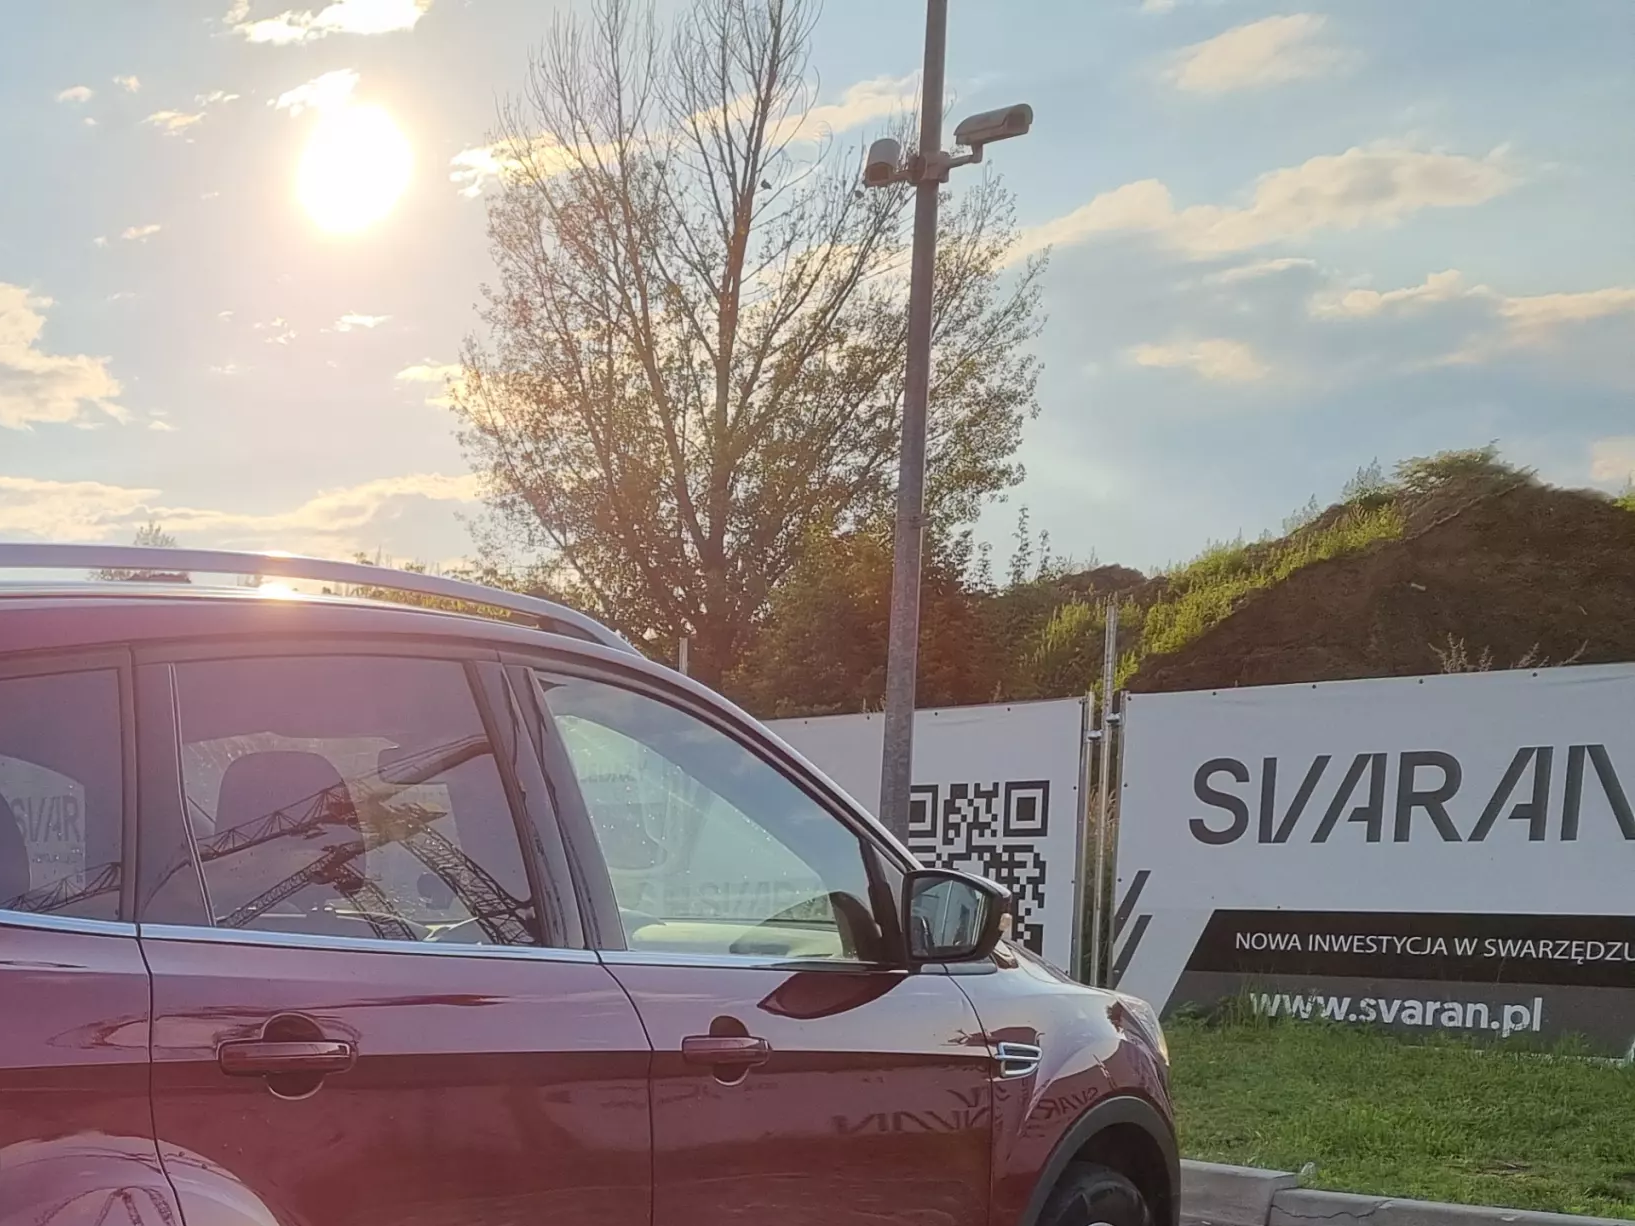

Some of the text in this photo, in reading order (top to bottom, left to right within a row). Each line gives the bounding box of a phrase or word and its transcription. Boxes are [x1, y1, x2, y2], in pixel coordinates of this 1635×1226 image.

[1188, 744, 1635, 845] SVARAN
[1235, 932, 1302, 951] NOWA
[1308, 934, 1449, 956] INWESTYCJA
[1454, 937, 1479, 957] W
[1249, 991, 1543, 1038] www.svaran.pl
